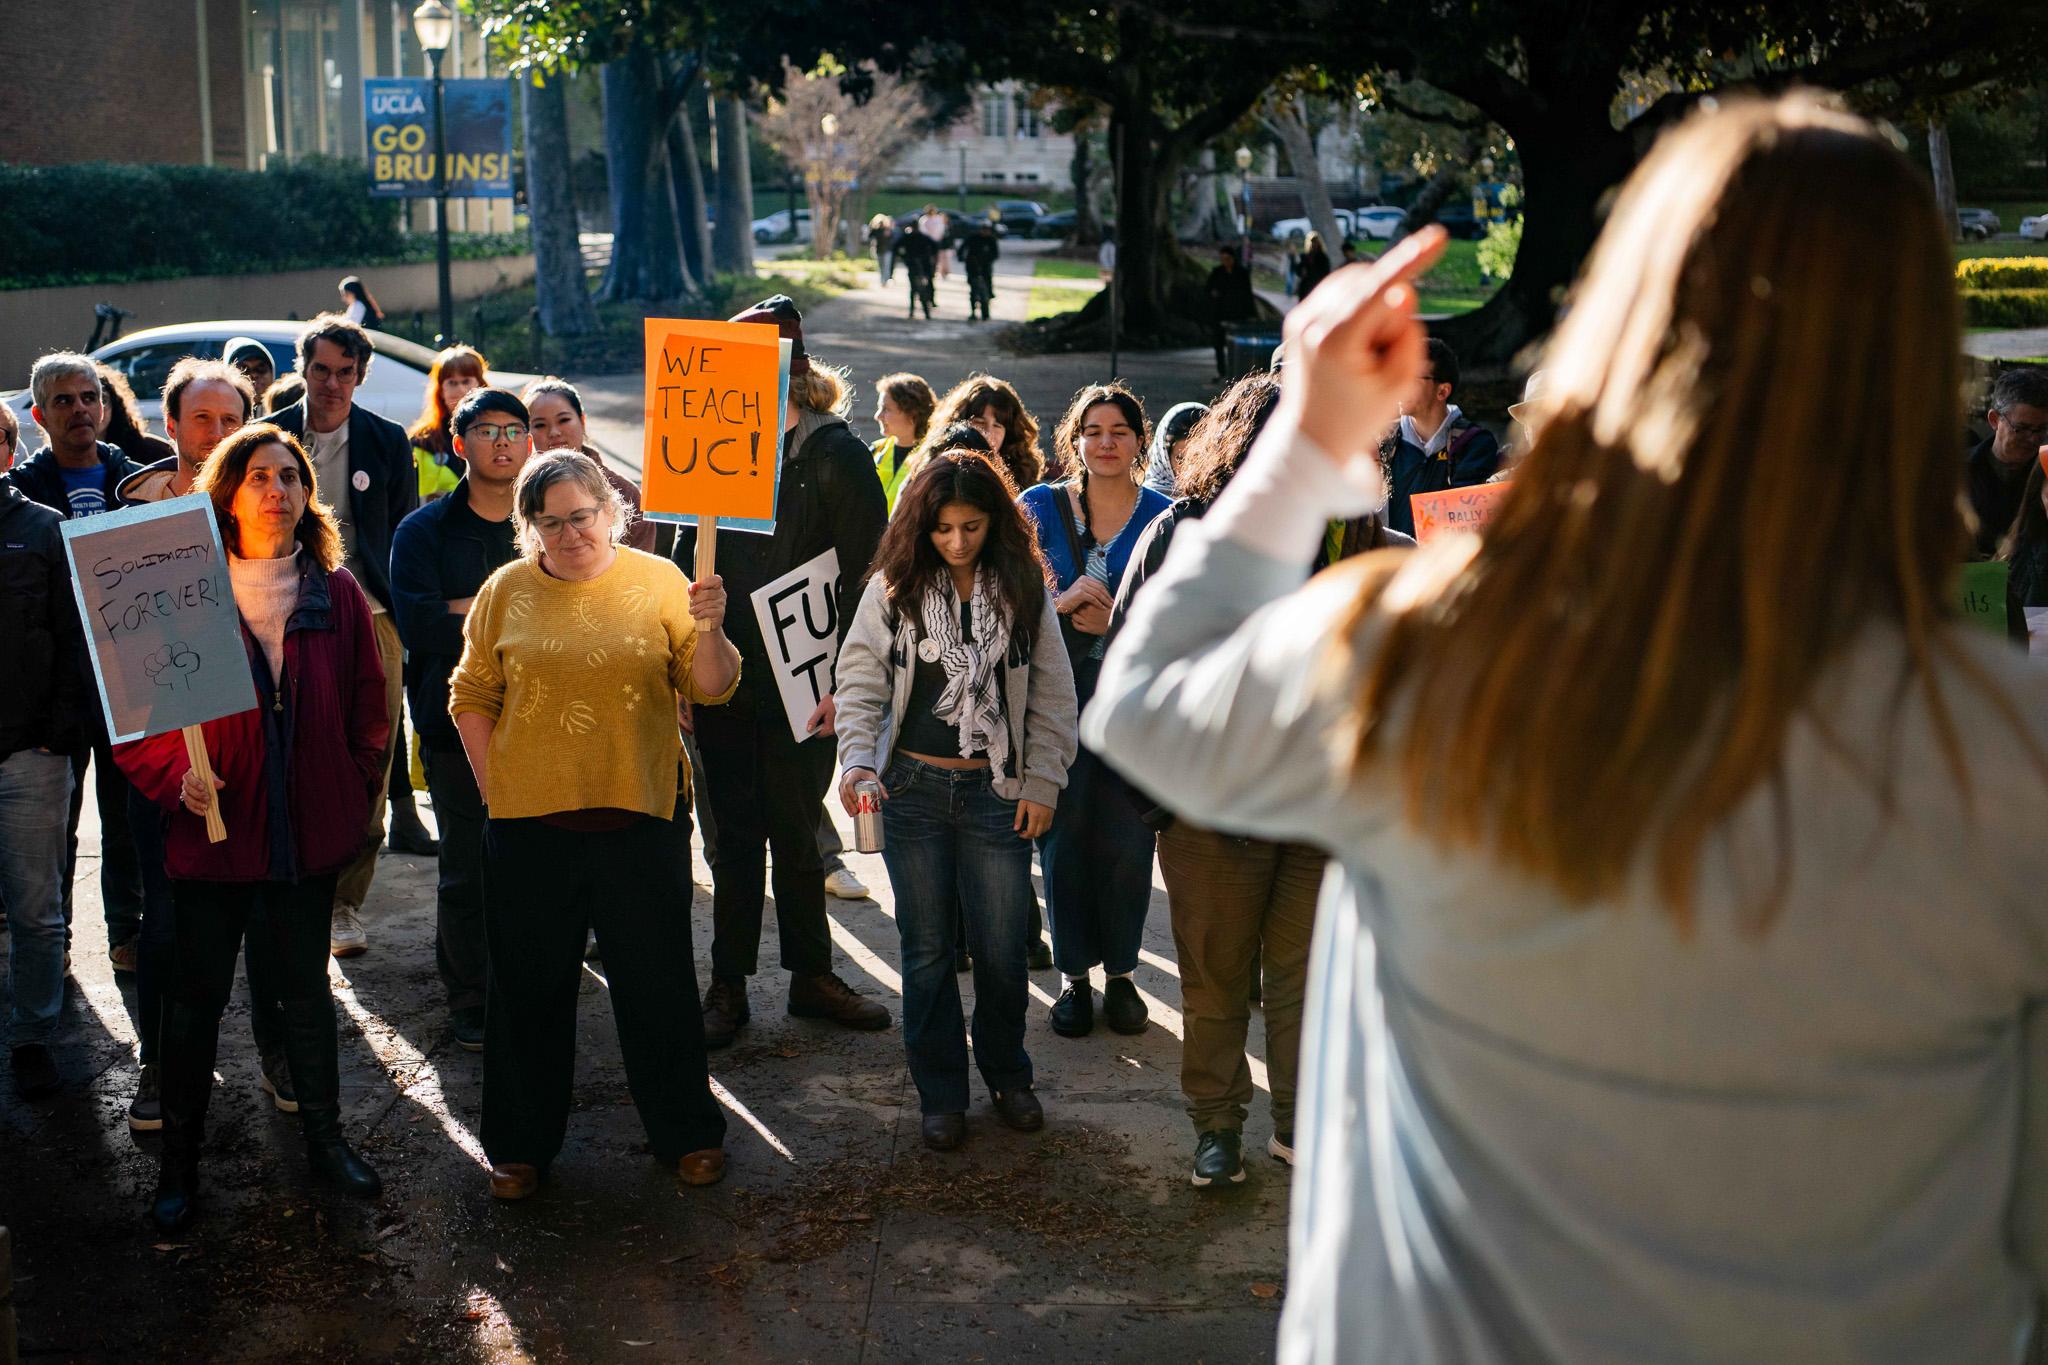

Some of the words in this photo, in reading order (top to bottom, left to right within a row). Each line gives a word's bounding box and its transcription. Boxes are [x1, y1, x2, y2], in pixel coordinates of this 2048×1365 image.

[372, 95, 426, 114] UCLA
[372, 124, 426, 152] GO
[663, 346, 723, 377] WE
[658, 386, 761, 427] TEACH
[661, 431, 761, 477] UC!
[1448, 510, 1482, 524] RALLY
[93, 543, 210, 590] SOLIDARITY
[98, 576, 219, 645] FOREVER!
[768, 575, 841, 664] FU
